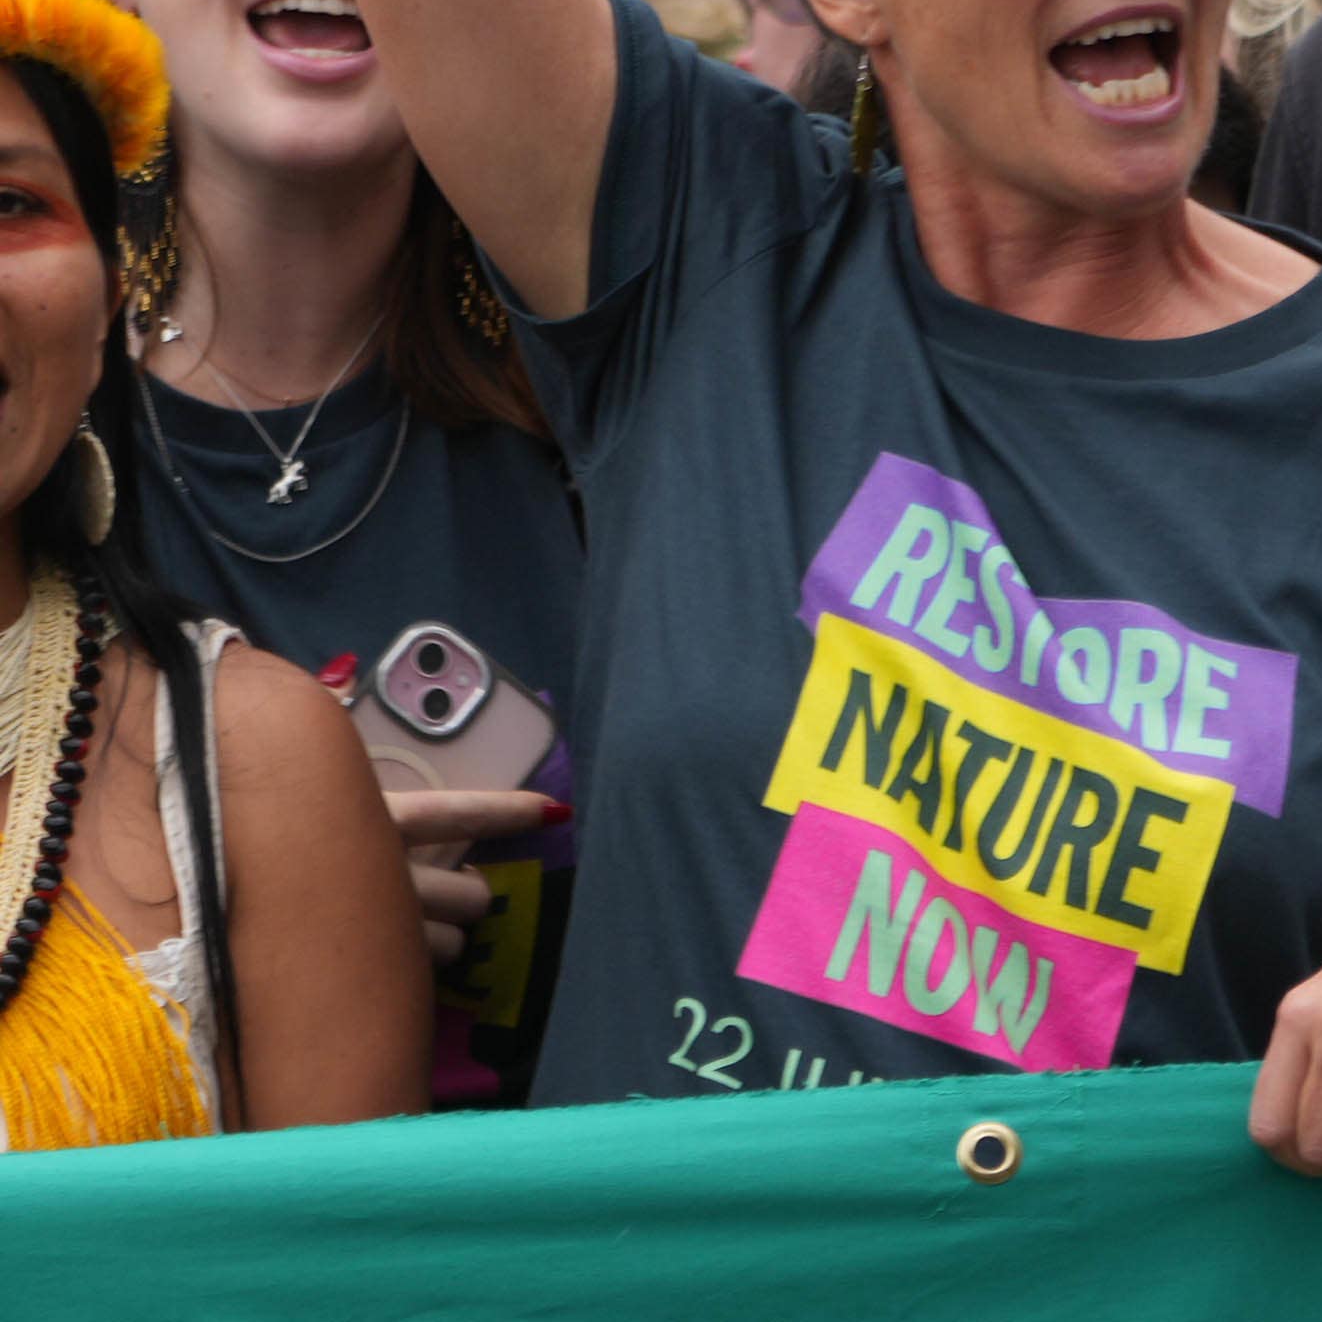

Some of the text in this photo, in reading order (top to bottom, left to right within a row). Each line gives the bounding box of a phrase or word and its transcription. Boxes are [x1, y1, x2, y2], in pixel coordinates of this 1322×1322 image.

[850, 503, 1239, 760] RESTORE
[818, 668, 1190, 932] NATURE
[668, 996, 755, 1091] 22
[823, 848, 1055, 1056] NOW
